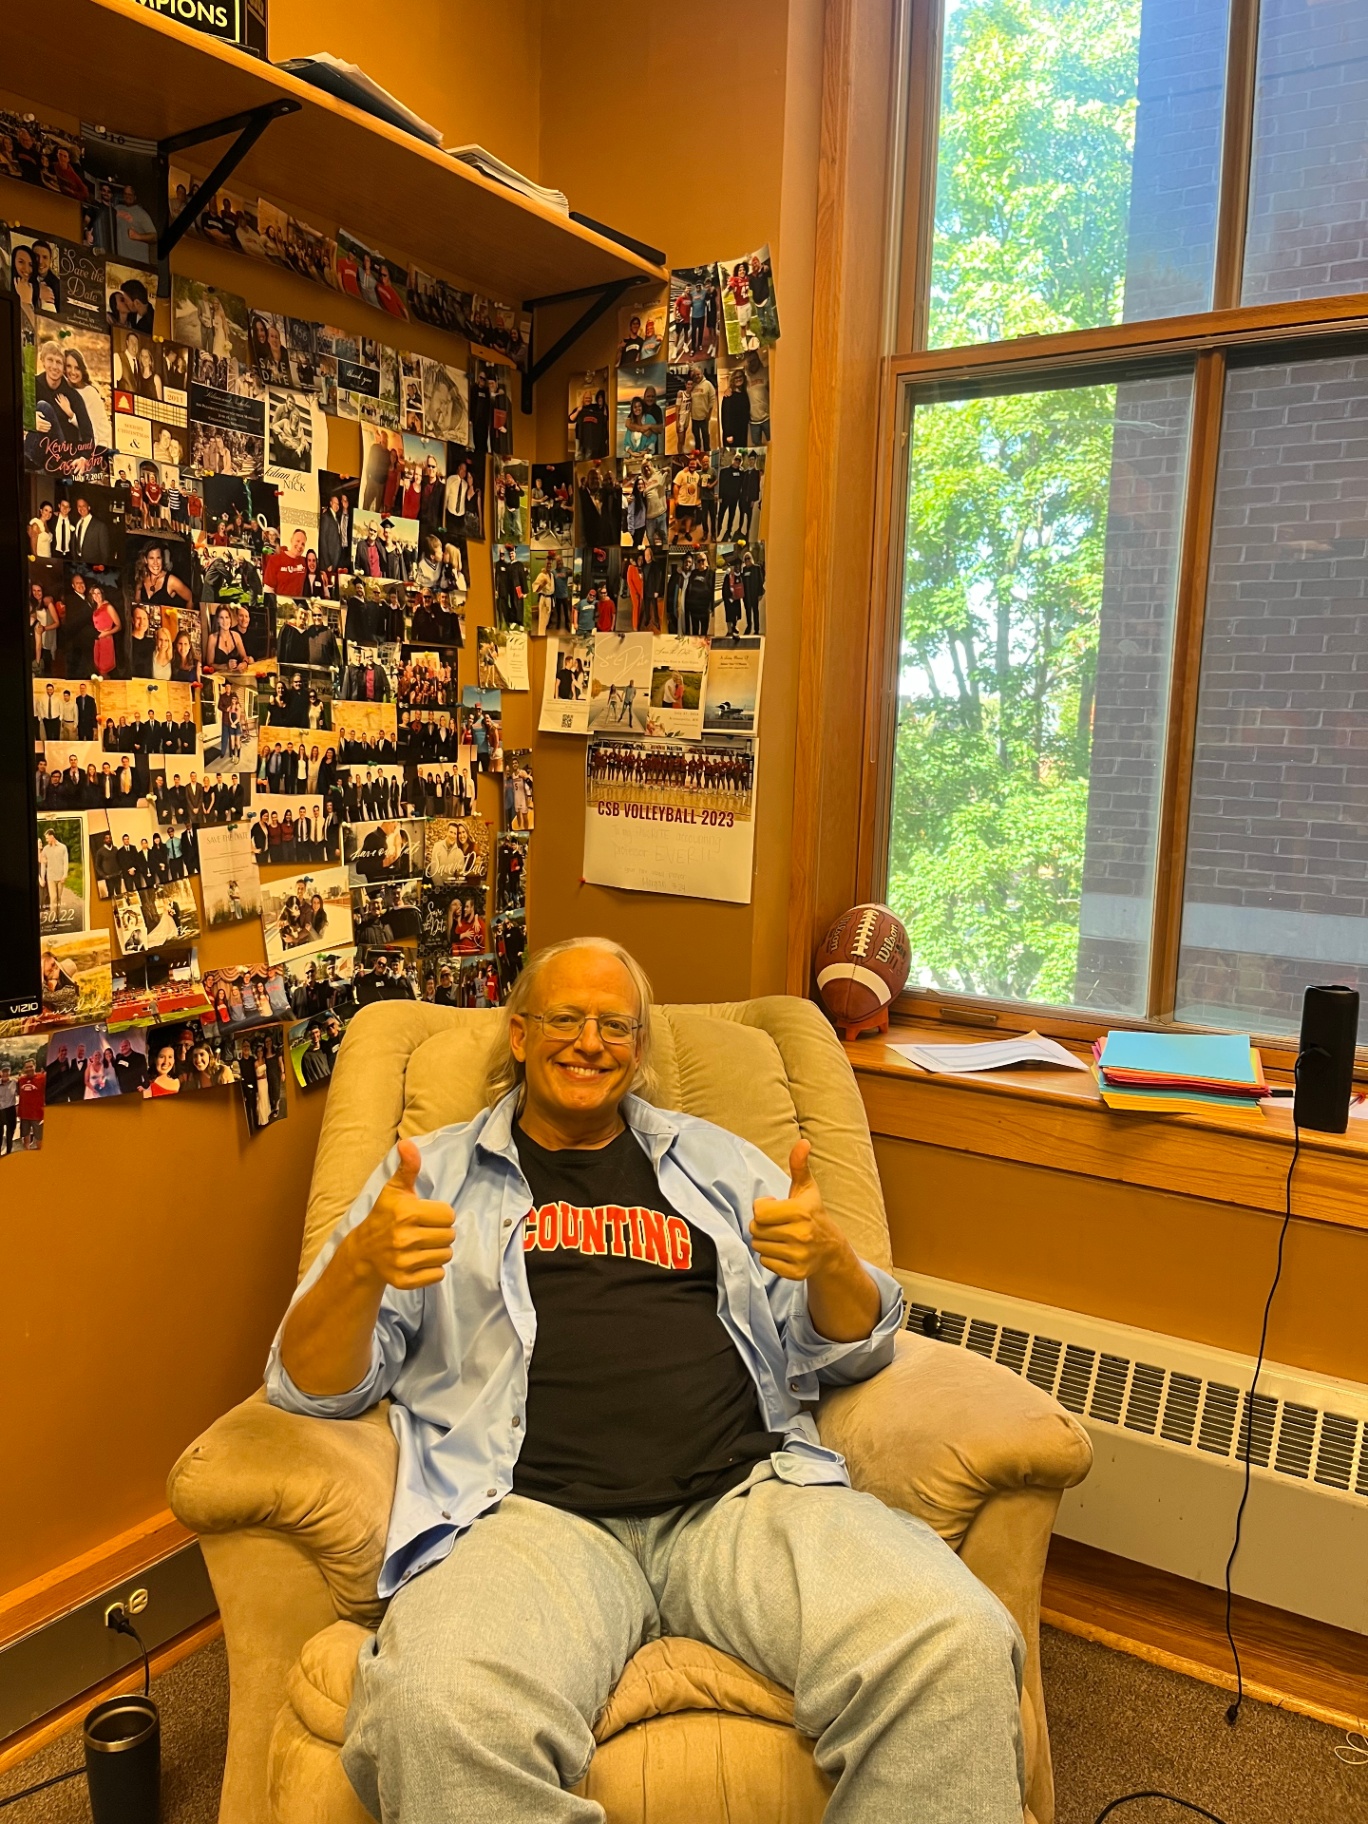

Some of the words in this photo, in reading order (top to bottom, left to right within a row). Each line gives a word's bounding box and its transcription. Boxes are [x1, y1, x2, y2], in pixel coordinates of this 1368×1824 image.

[59, 248, 89, 278] Save
[66, 276, 98, 302] Date
[166, 393, 184, 404] 2011
[39, 436, 78, 456] Kevin
[78, 438, 94, 451] and
[129, 438, 141, 450] &
[283, 479, 306, 493] NICK
[597, 800, 620, 817] CSB
[624, 803, 697, 824] VOLLEYBALL
[701, 809, 735, 828] 2023
[206, 835, 221, 846] SAVE
[425, 850, 455, 878] Save
[459, 850, 487, 877] Date
[426, 900, 444, 919] Save
[429, 918, 447, 937] Date
[875, 922, 899, 964] Wilson
[9, 1002, 39, 1014] VIZIO
[522, 1200, 692, 1270] COUNTING
